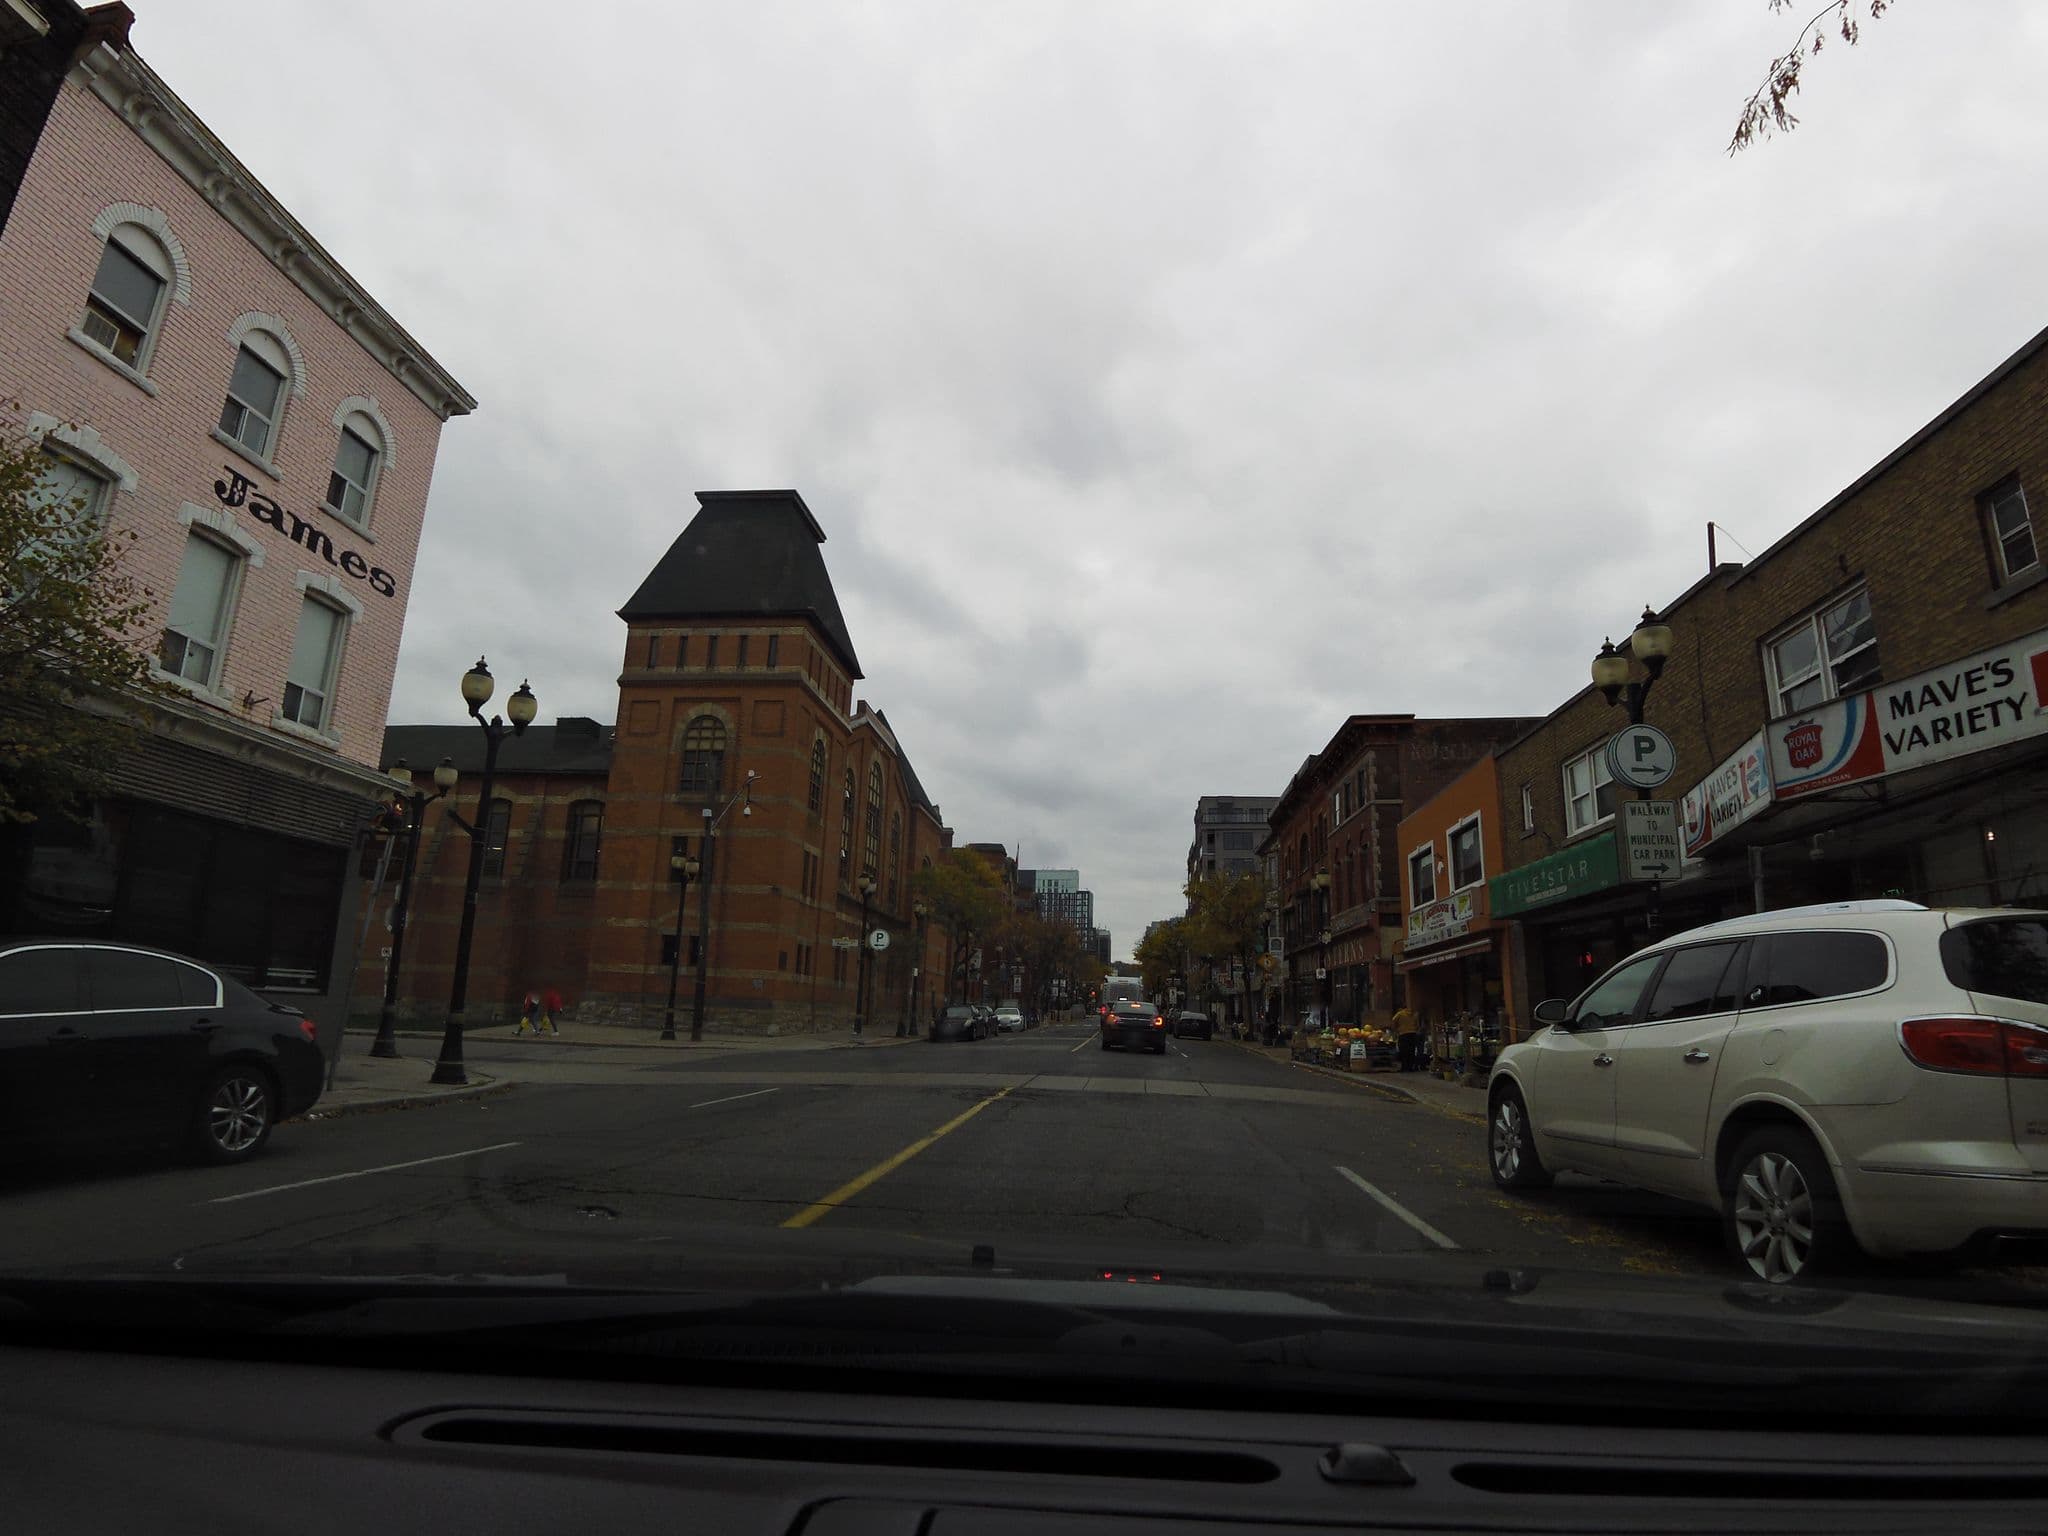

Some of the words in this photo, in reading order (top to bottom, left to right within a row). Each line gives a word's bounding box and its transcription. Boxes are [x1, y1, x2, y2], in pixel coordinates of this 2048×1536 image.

[214, 465, 396, 598] James
[1889, 657, 2014, 720] MAVE'S
[1884, 691, 2028, 755] VARIETY
[1788, 731, 1818, 748] ROYAL
[1633, 735, 1656, 762] P
[1795, 746, 1817, 761] OAK
[1630, 805, 1670, 817] WALKWAY
[1710, 794, 1742, 828] VARIETY
[1647, 820, 1658, 830] TO
[1630, 834, 1676, 846] MUNICIPAL
[1633, 849, 1650, 860] CAR
[1654, 849, 1676, 860] PARK
[1508, 875, 1540, 898] FIVE
[1548, 860, 1588, 887] STAR
[876, 933, 884, 942] P
